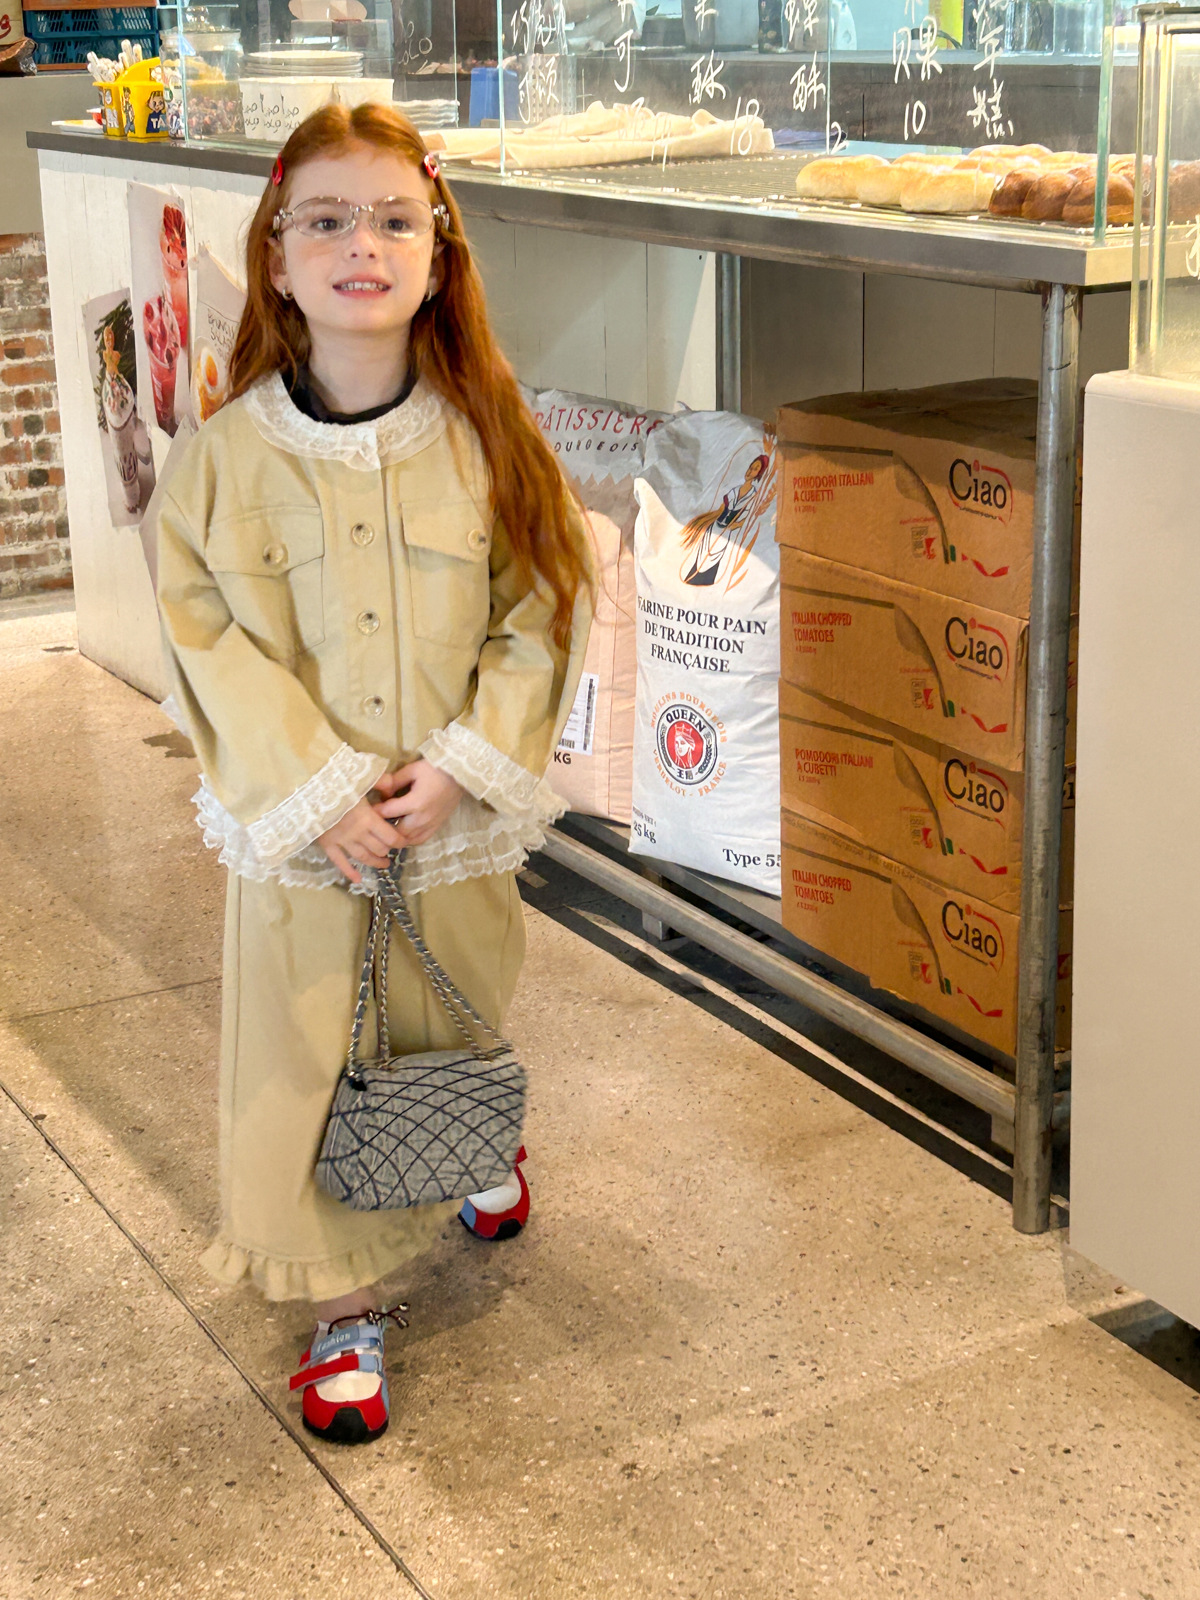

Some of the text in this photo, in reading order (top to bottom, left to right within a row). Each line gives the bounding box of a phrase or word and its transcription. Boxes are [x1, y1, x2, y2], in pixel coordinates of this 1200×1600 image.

[730, 96, 760, 155] 18
[903, 100, 927, 140] 10
[948, 458, 1007, 509] Ciao
[644, 619, 745, 654] DE TRADITION
[676, 608, 719, 629] POUR
[723, 616, 768, 635] PAIN
[651, 643, 731, 673] FRANÇAISE
[945, 616, 1004, 670] Ciao
[665, 708, 707, 733] QUEEN
[553, 751, 571, 765] KG
[803, 761, 837, 776] CUBETTI
[944, 758, 1005, 813] Ciao
[643, 823, 656, 844] kg
[722, 848, 761, 868] Type
[793, 885, 835, 905] TOMATOES
[941, 900, 998, 958] Ciao
